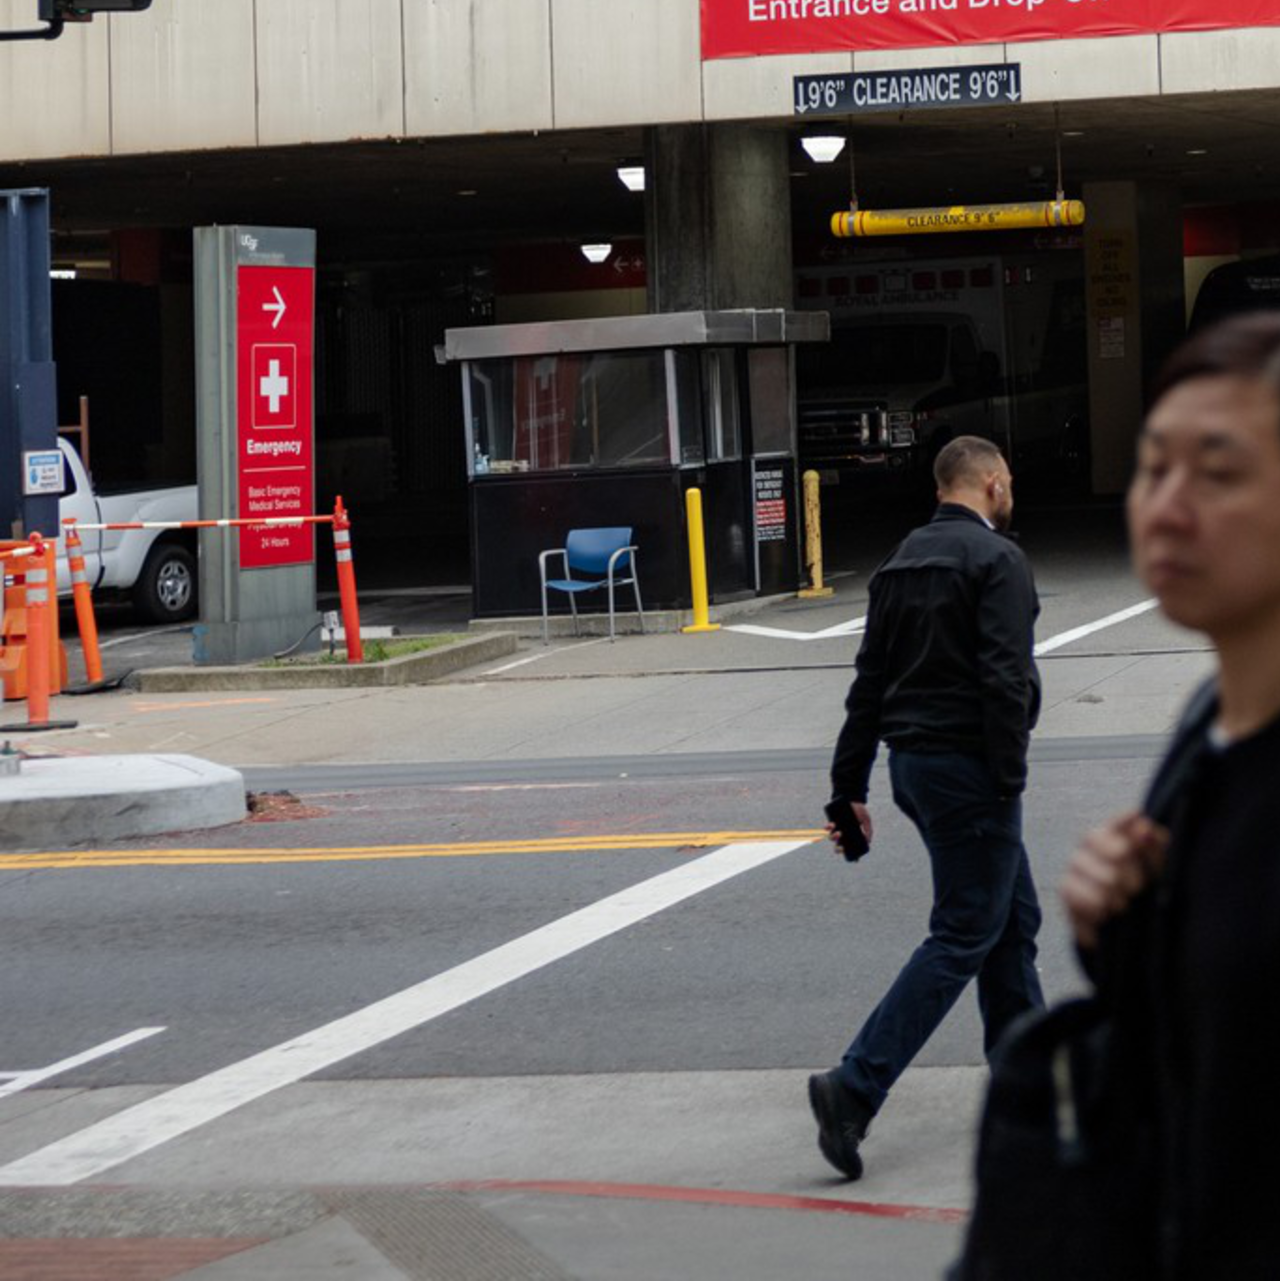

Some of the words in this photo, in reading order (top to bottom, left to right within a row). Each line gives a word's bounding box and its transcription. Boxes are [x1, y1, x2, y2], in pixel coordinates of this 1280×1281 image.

[853, 73, 961, 106] CLEARANCE
[907, 211, 970, 227] CLEARANCE
[247, 439, 302, 456] Emergency
[267, 485, 301, 499] Emergency
